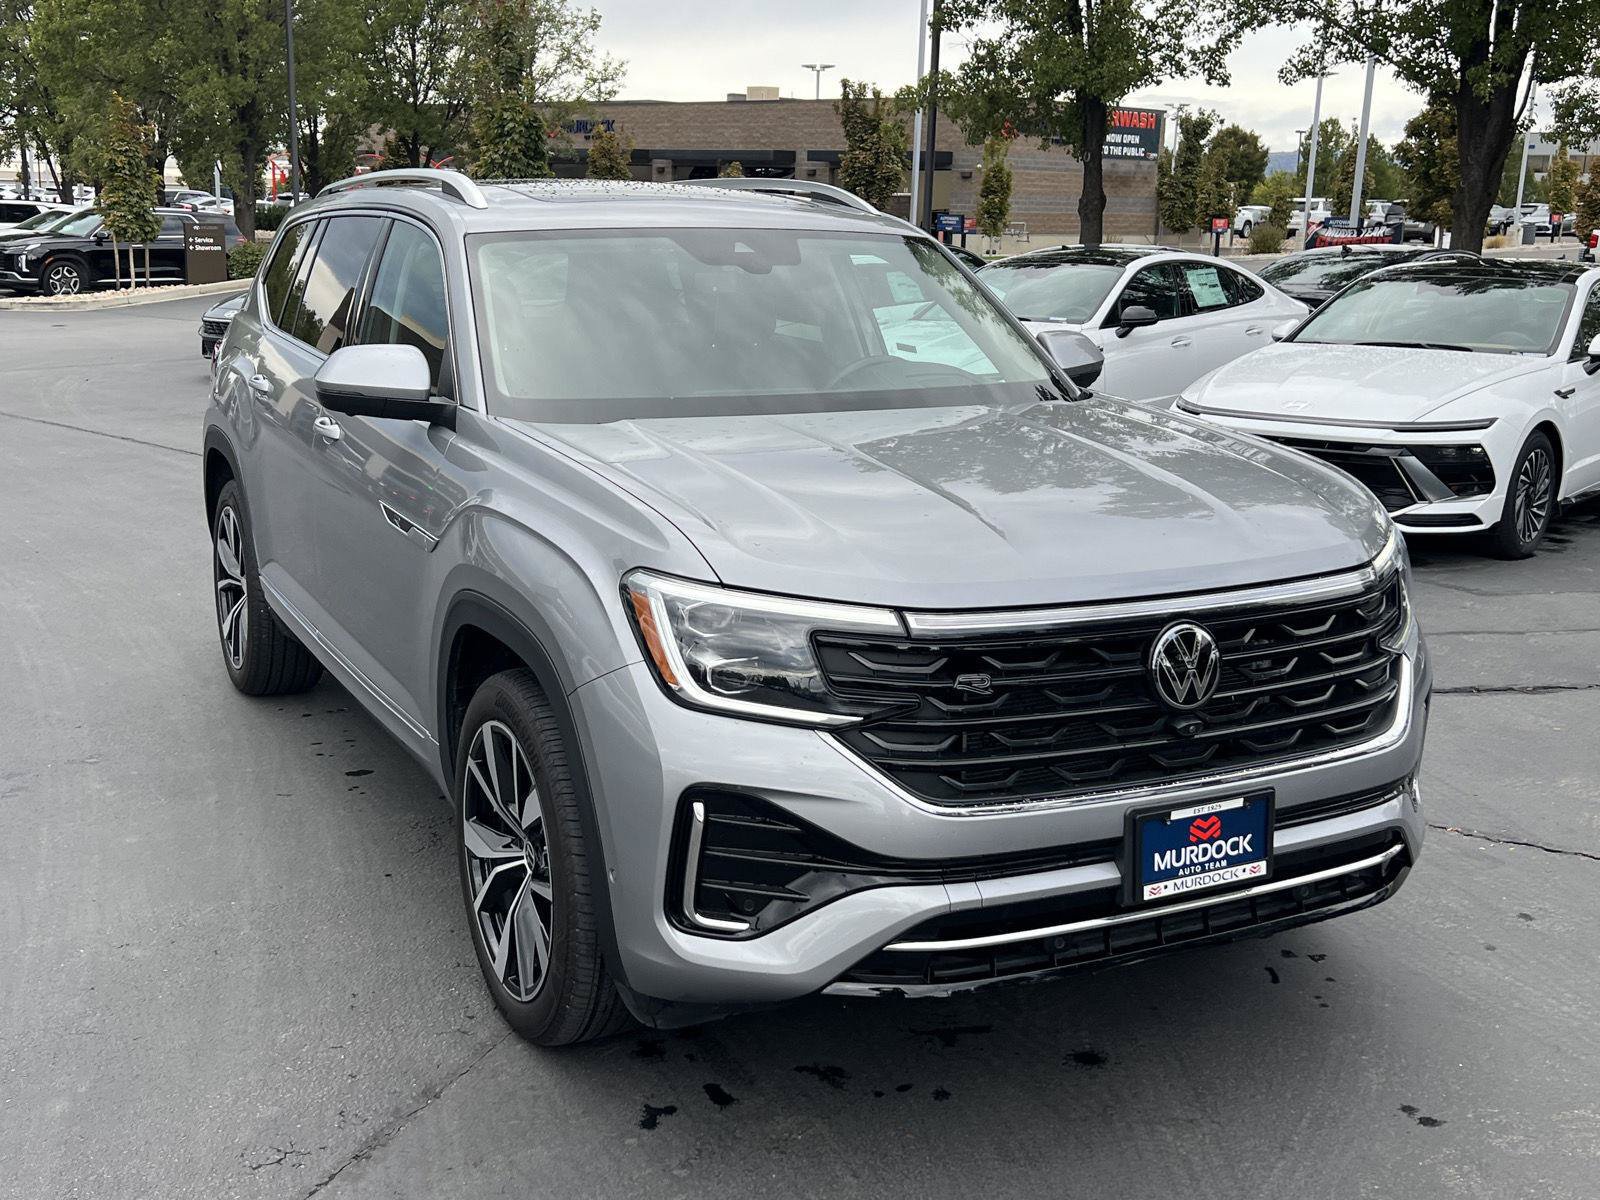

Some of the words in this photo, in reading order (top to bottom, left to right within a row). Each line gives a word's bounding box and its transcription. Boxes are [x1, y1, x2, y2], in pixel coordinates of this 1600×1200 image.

[1106, 133, 1122, 142] NOW
[1123, 135, 1140, 144] OPEN
[1110, 146, 1122, 155] THE
[1123, 147, 1145, 157] PUBLIC
[1360, 226, 1386, 237] YEAR
[1153, 833, 1253, 872] MURDOCK
[1178, 865, 1202, 876] AUTO
[1204, 859, 1228, 871] TEAM
[1173, 869, 1239, 891] MURDOCK
